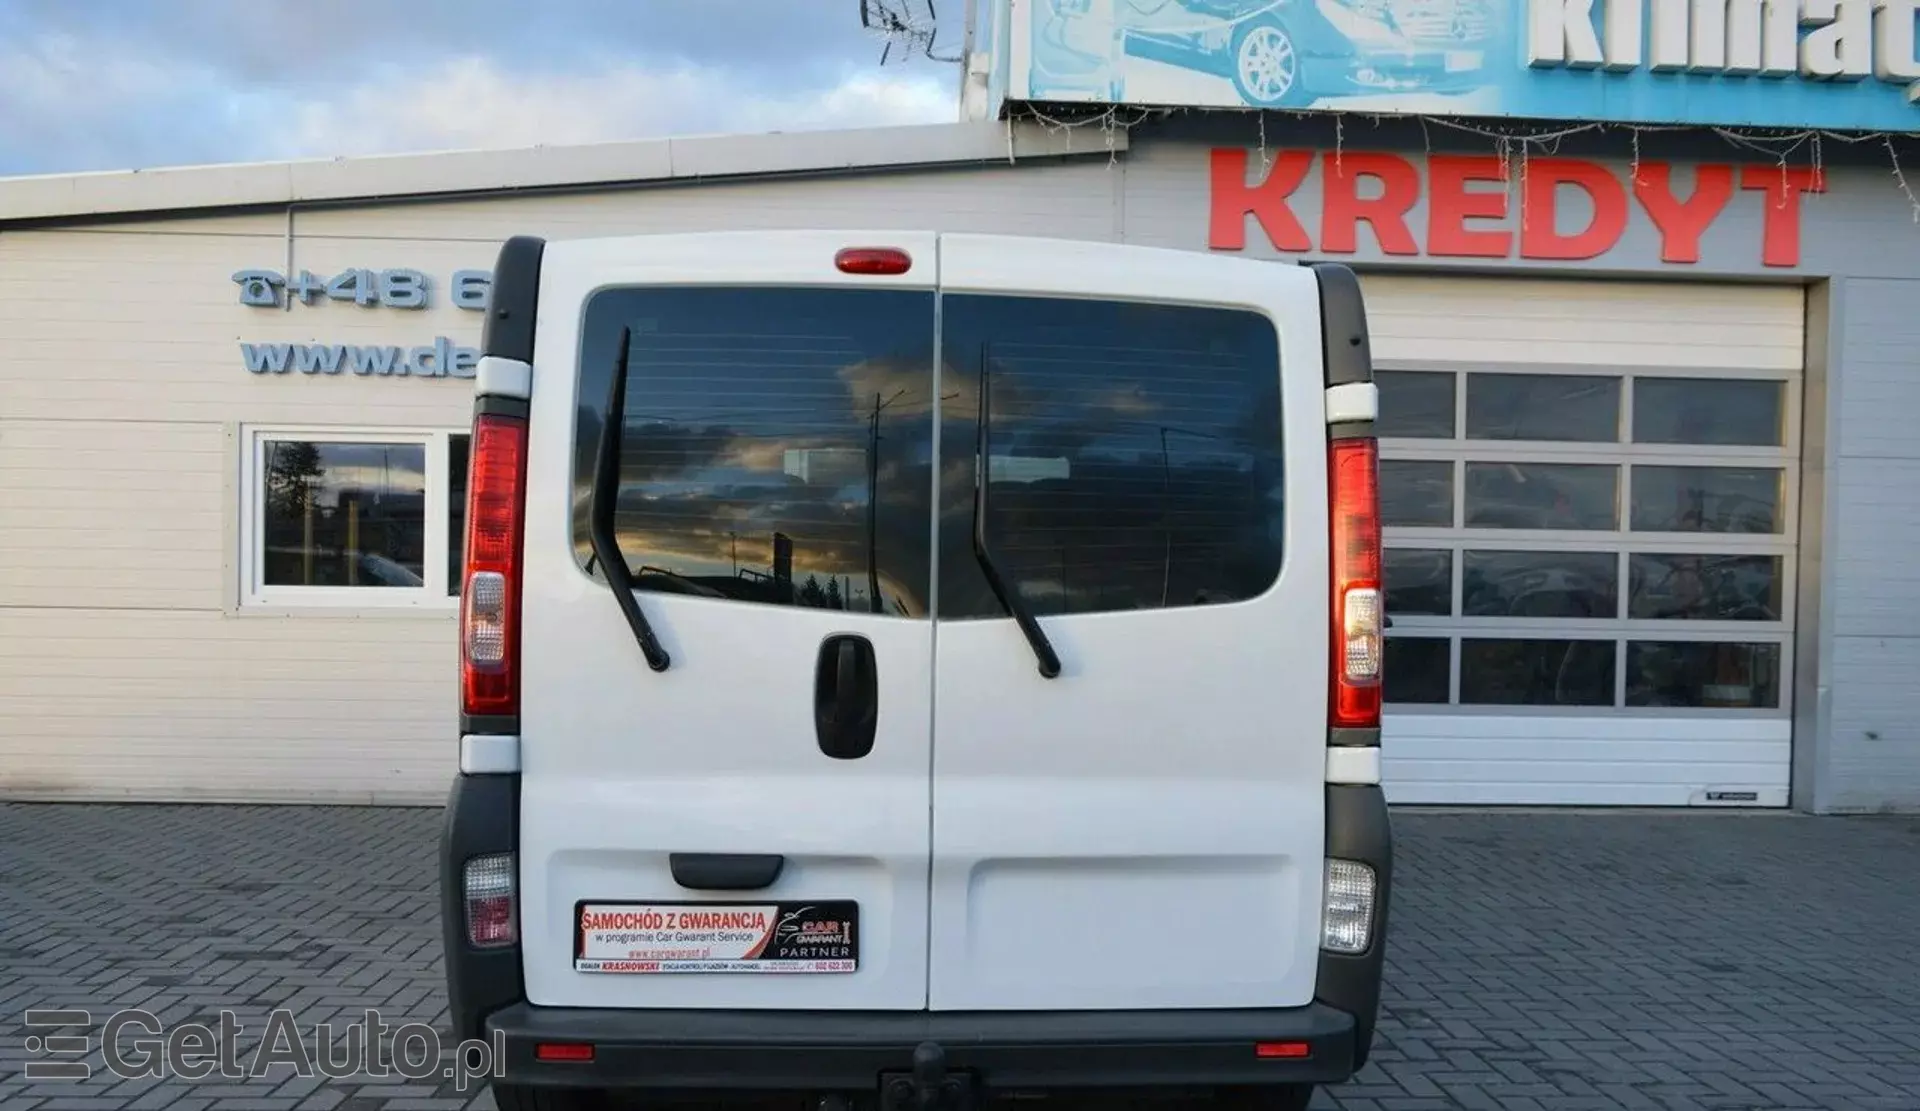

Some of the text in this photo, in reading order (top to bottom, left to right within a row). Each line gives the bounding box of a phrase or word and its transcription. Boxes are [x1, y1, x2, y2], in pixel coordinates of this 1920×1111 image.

[1208, 147, 1827, 268] KREDYT
[240, 336, 478, 377] www.de
[583, 908, 766, 932] SAMOCHÓD Z GWARANCJĄ
[802, 921, 839, 932] CAR
[606, 932, 653, 944] programie
[656, 932, 672, 941] Car
[675, 931, 716, 942] Gwarant
[718, 931, 754, 942] Service
[796, 934, 843, 944] GWARANT
[780, 947, 850, 957] PARTNER
